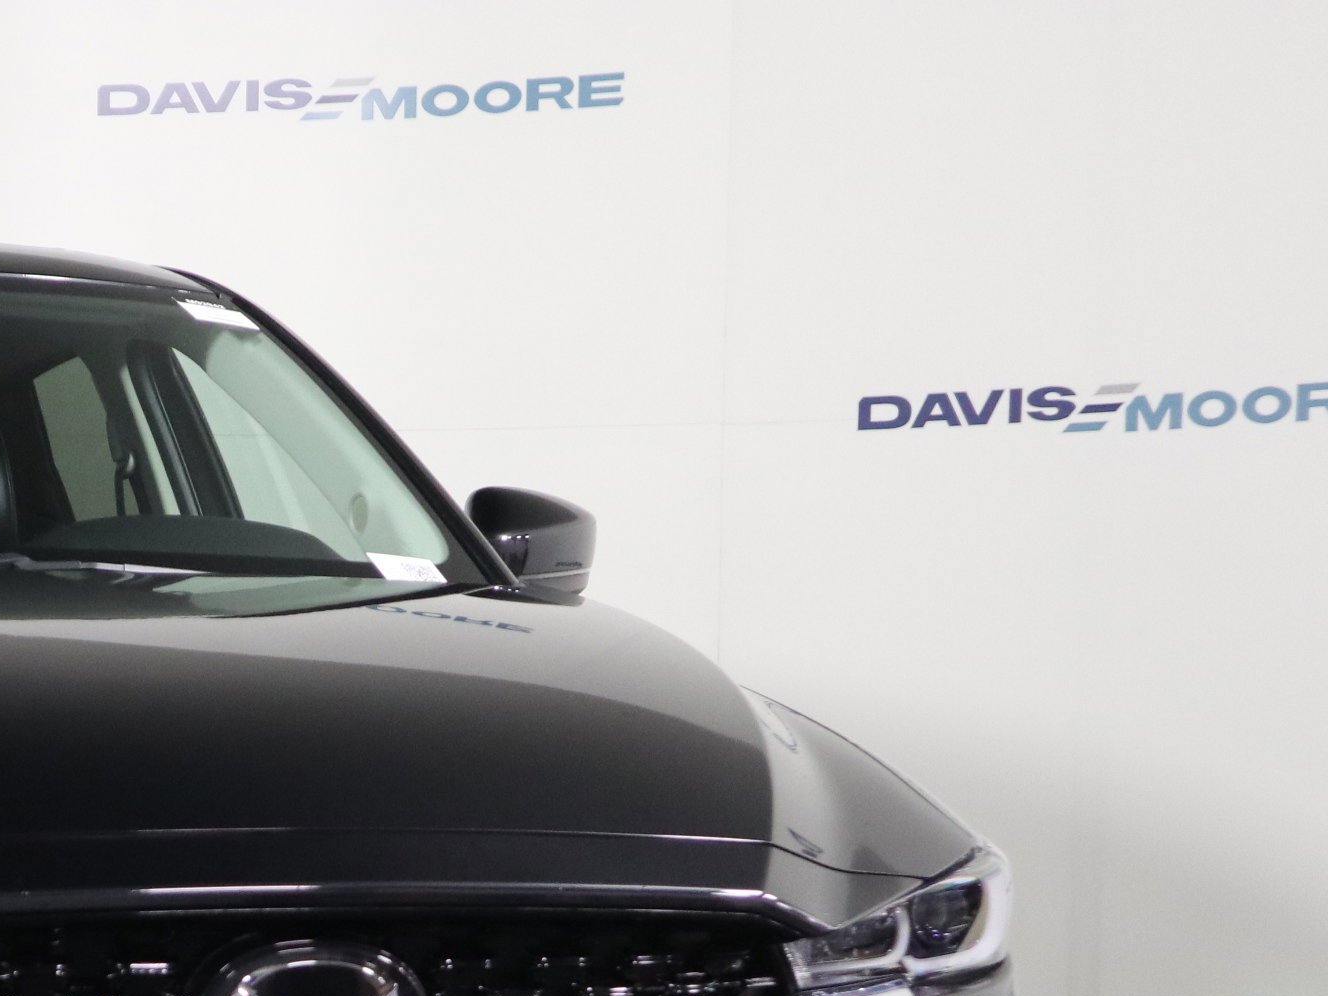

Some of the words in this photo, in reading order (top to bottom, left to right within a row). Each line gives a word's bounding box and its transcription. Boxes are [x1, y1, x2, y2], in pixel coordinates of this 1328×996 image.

[96, 78, 314, 117] DAVIS
[360, 72, 625, 121] MOORE
[857, 385, 1077, 432] DAVIS
[1123, 382, 1328, 433] MOOR
